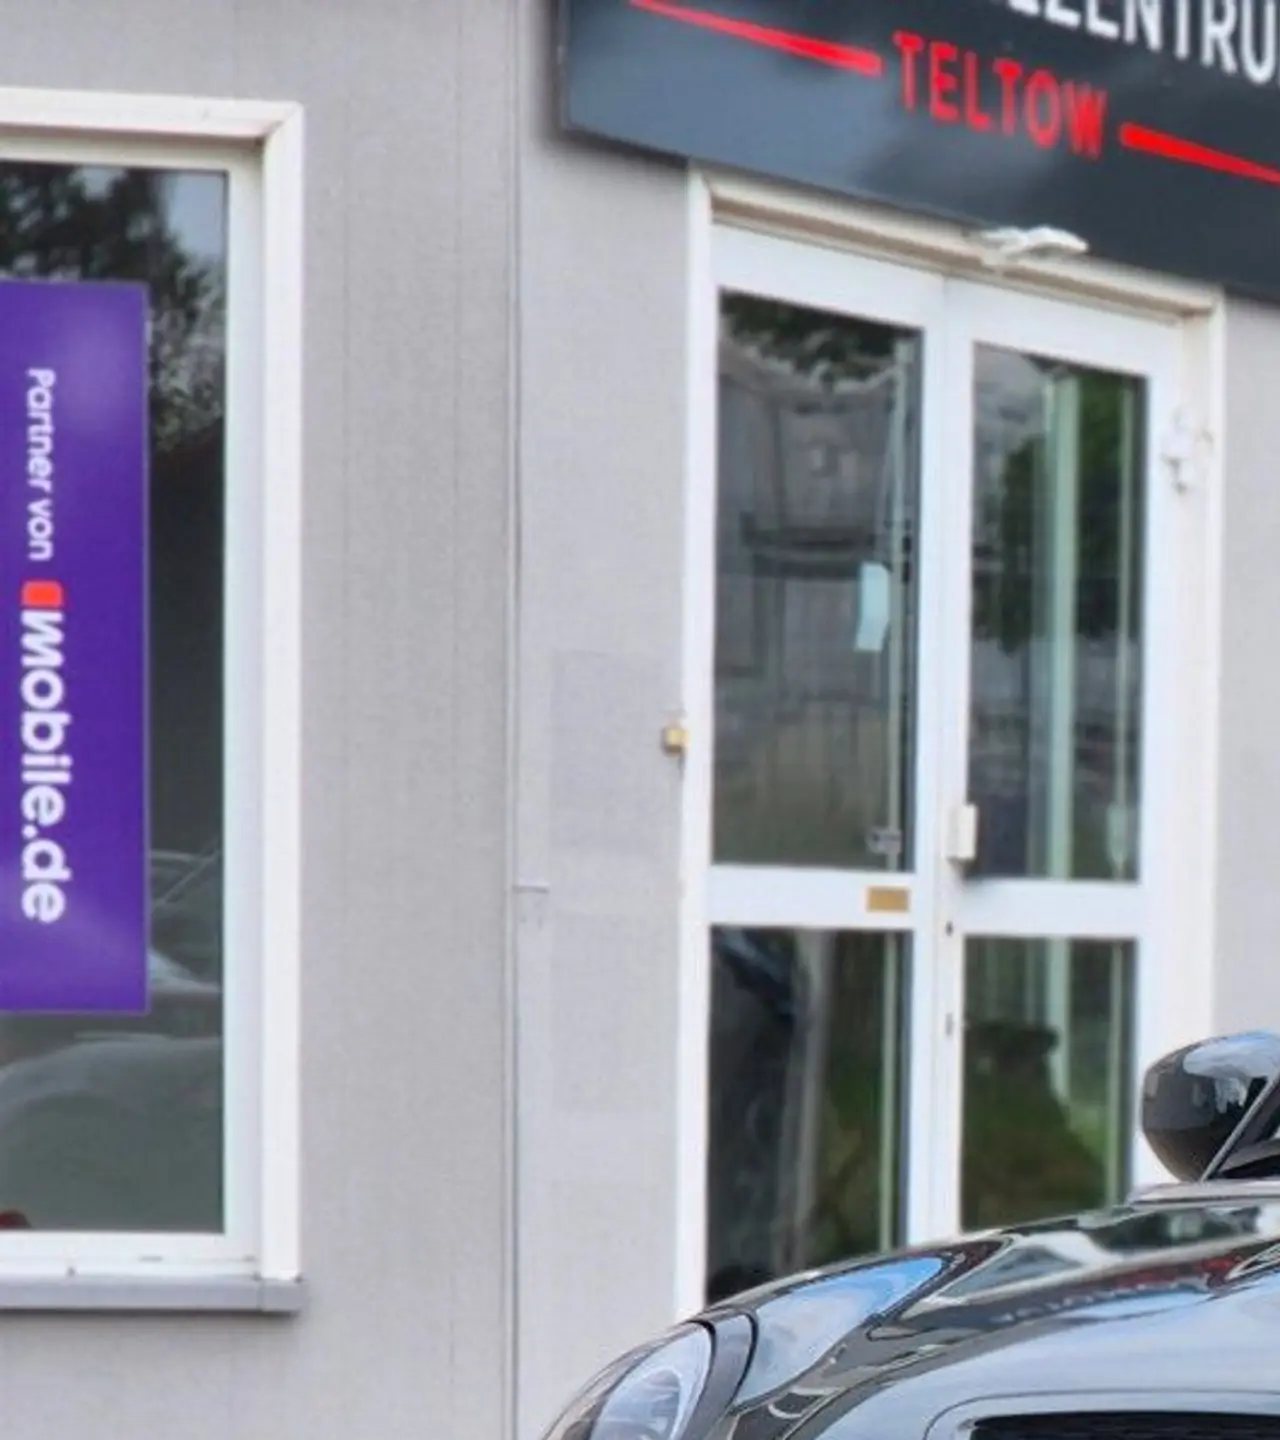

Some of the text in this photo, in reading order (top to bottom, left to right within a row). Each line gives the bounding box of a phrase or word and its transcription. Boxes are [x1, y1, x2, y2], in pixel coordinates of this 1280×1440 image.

[893, 31, 1108, 160] TELTOW
[26, 368, 56, 562] Partner von
[20, 609, 72, 924] mobile.de
